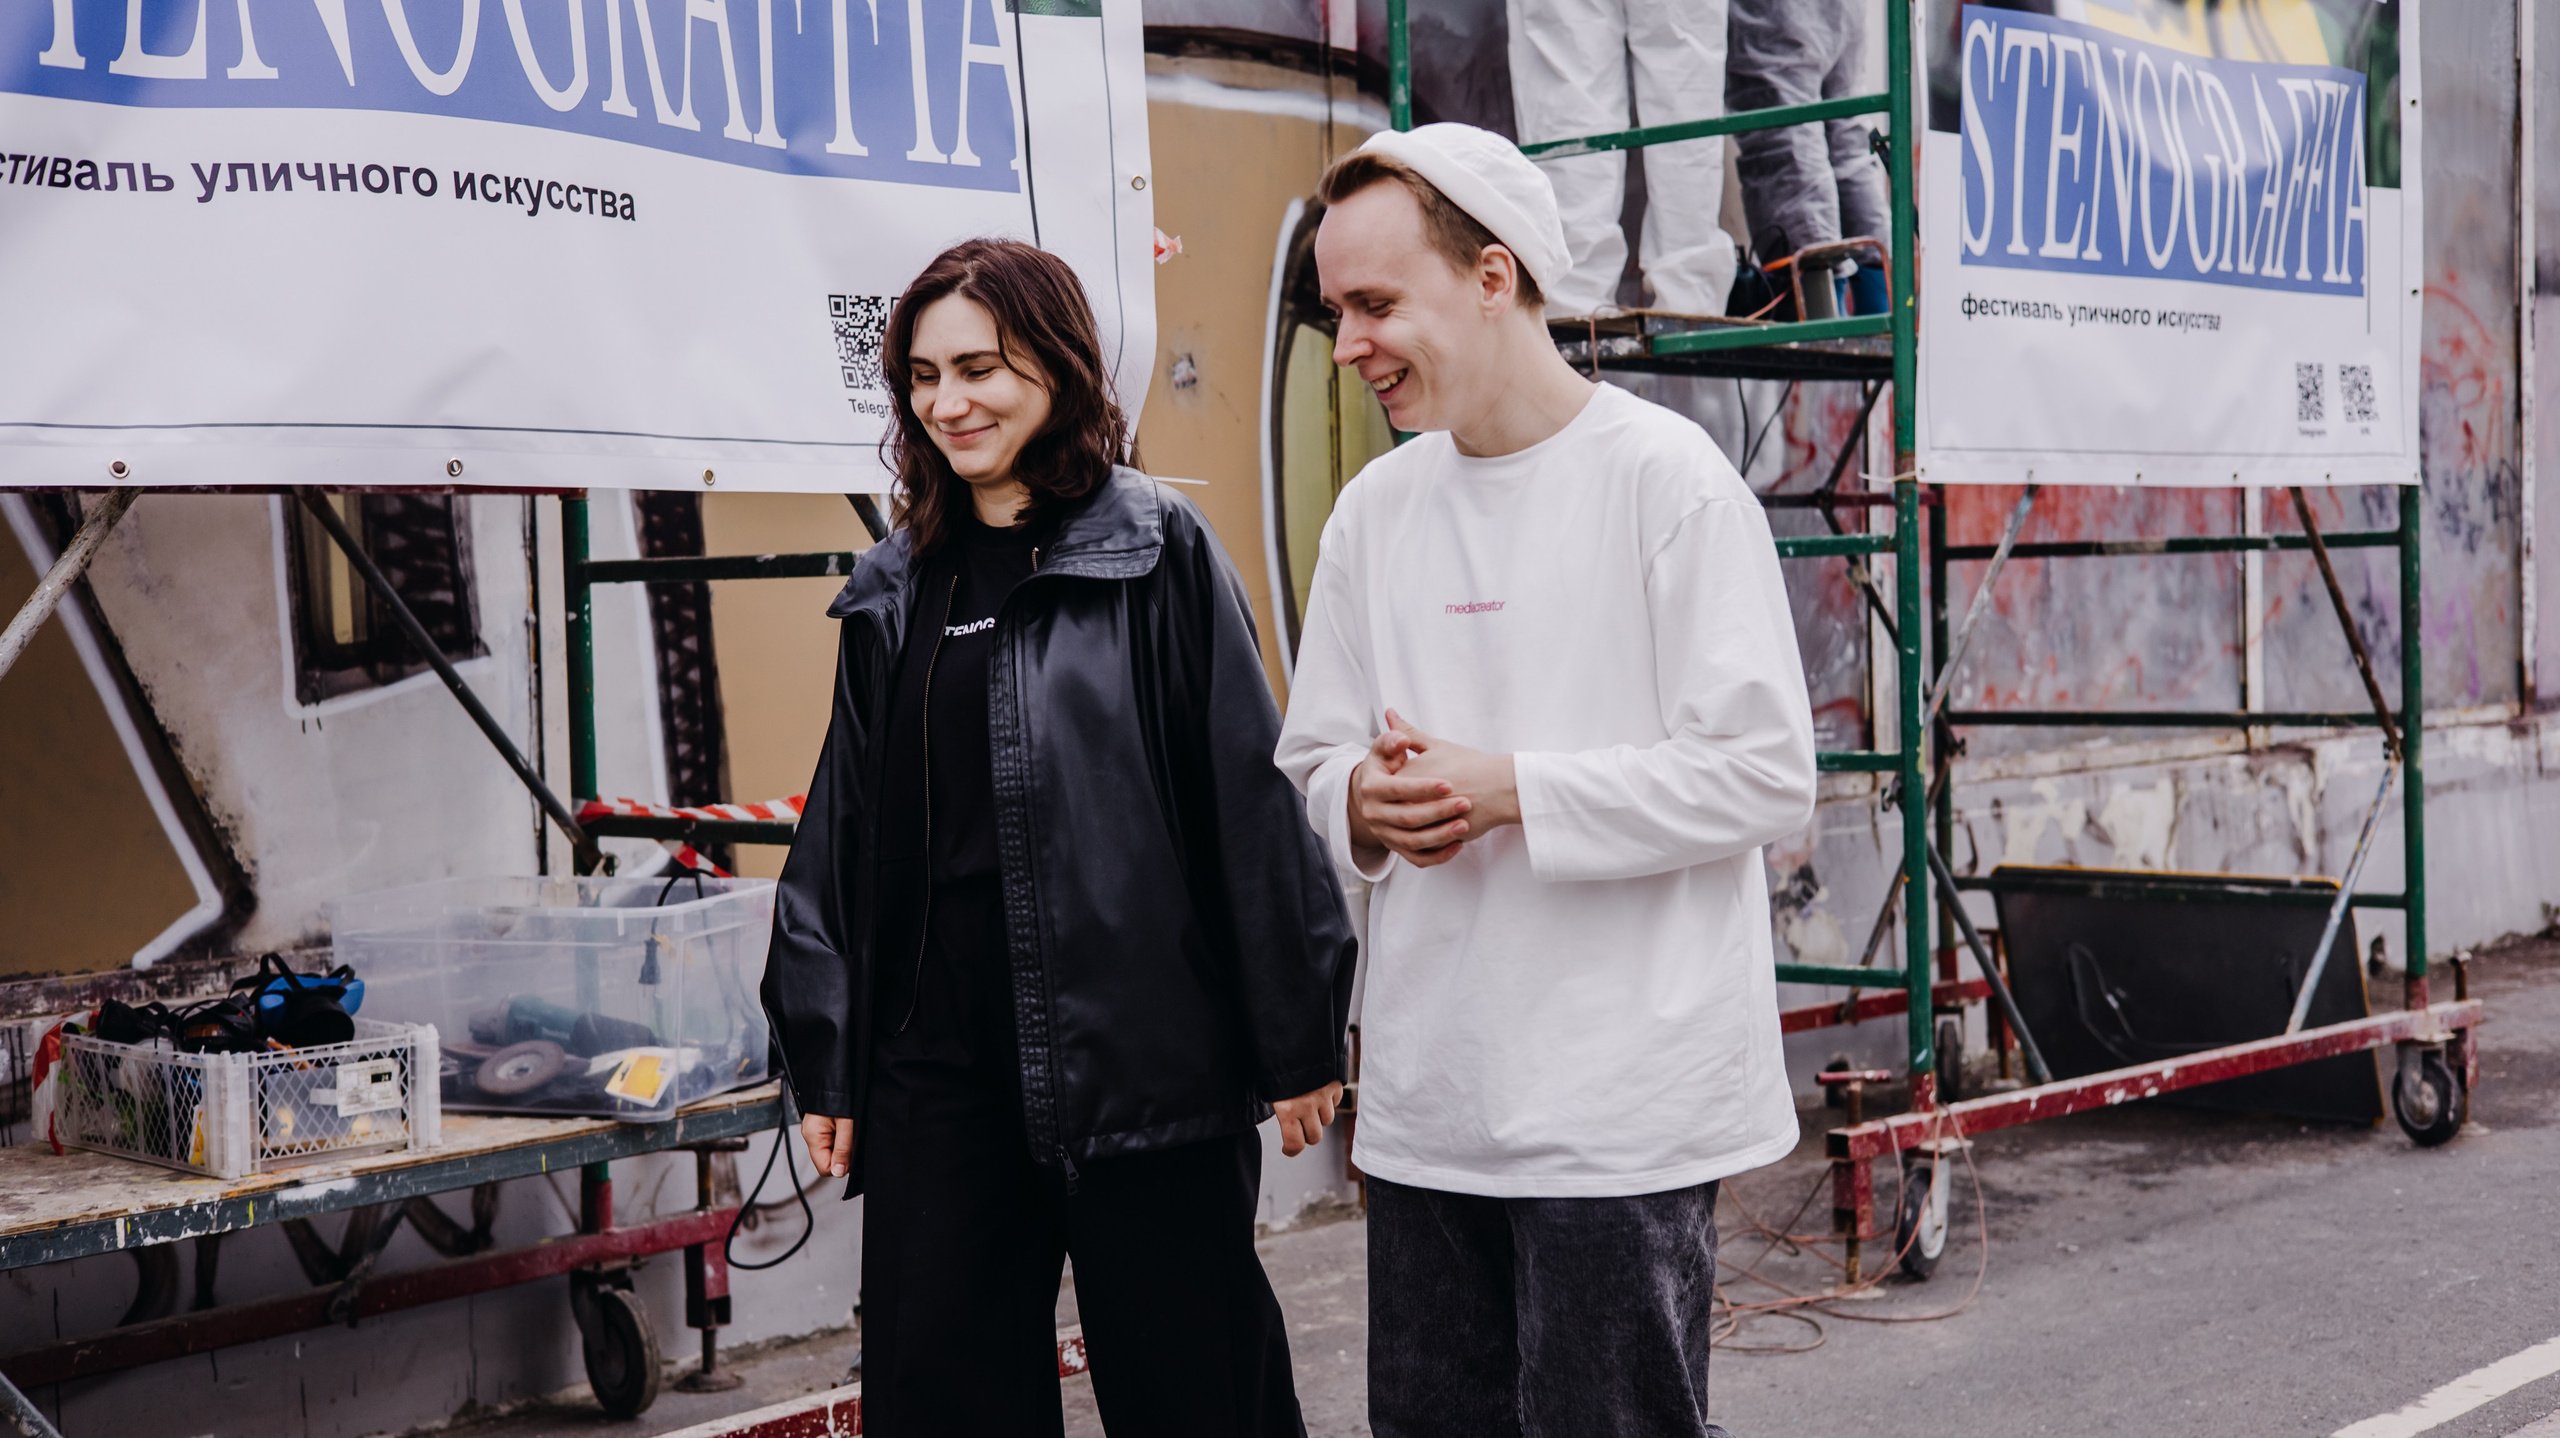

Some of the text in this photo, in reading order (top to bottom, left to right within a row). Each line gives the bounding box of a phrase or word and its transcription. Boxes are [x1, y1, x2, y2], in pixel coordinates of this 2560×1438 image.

[1961, 18, 2366, 284] STENOGRAFFIA
[190, 161, 438, 203] уличного
[453, 170, 636, 222] искусства
[1961, 292, 2063, 320] фестиваль
[2067, 302, 2151, 327] уличного
[848, 398, 890, 419] Telegr
